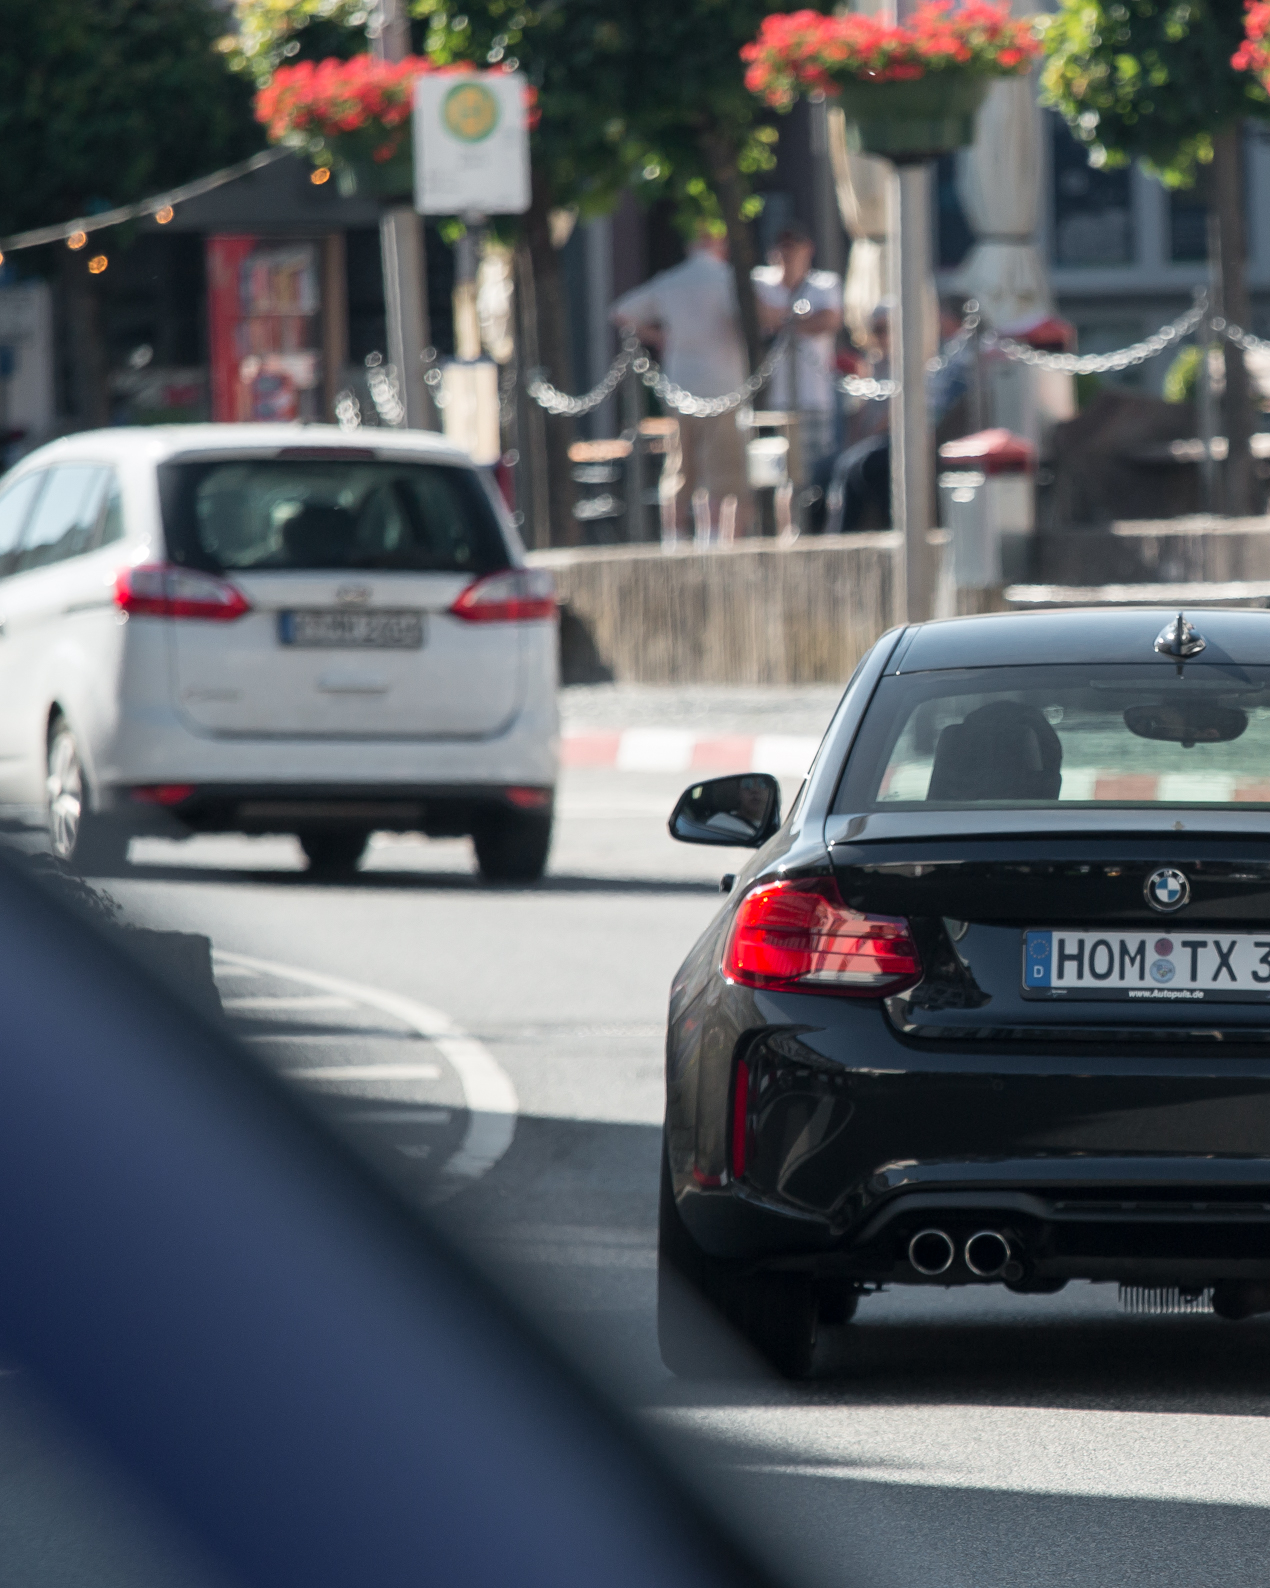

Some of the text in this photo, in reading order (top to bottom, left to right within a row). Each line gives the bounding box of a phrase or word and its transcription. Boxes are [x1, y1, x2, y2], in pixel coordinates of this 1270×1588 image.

[1152, 869, 1185, 883] BMW
[1056, 938, 1147, 982] HOM
[1181, 939, 1238, 983] TX
[1033, 965, 1044, 979] D
[1128, 988, 1204, 999] www.Autopuls.de
